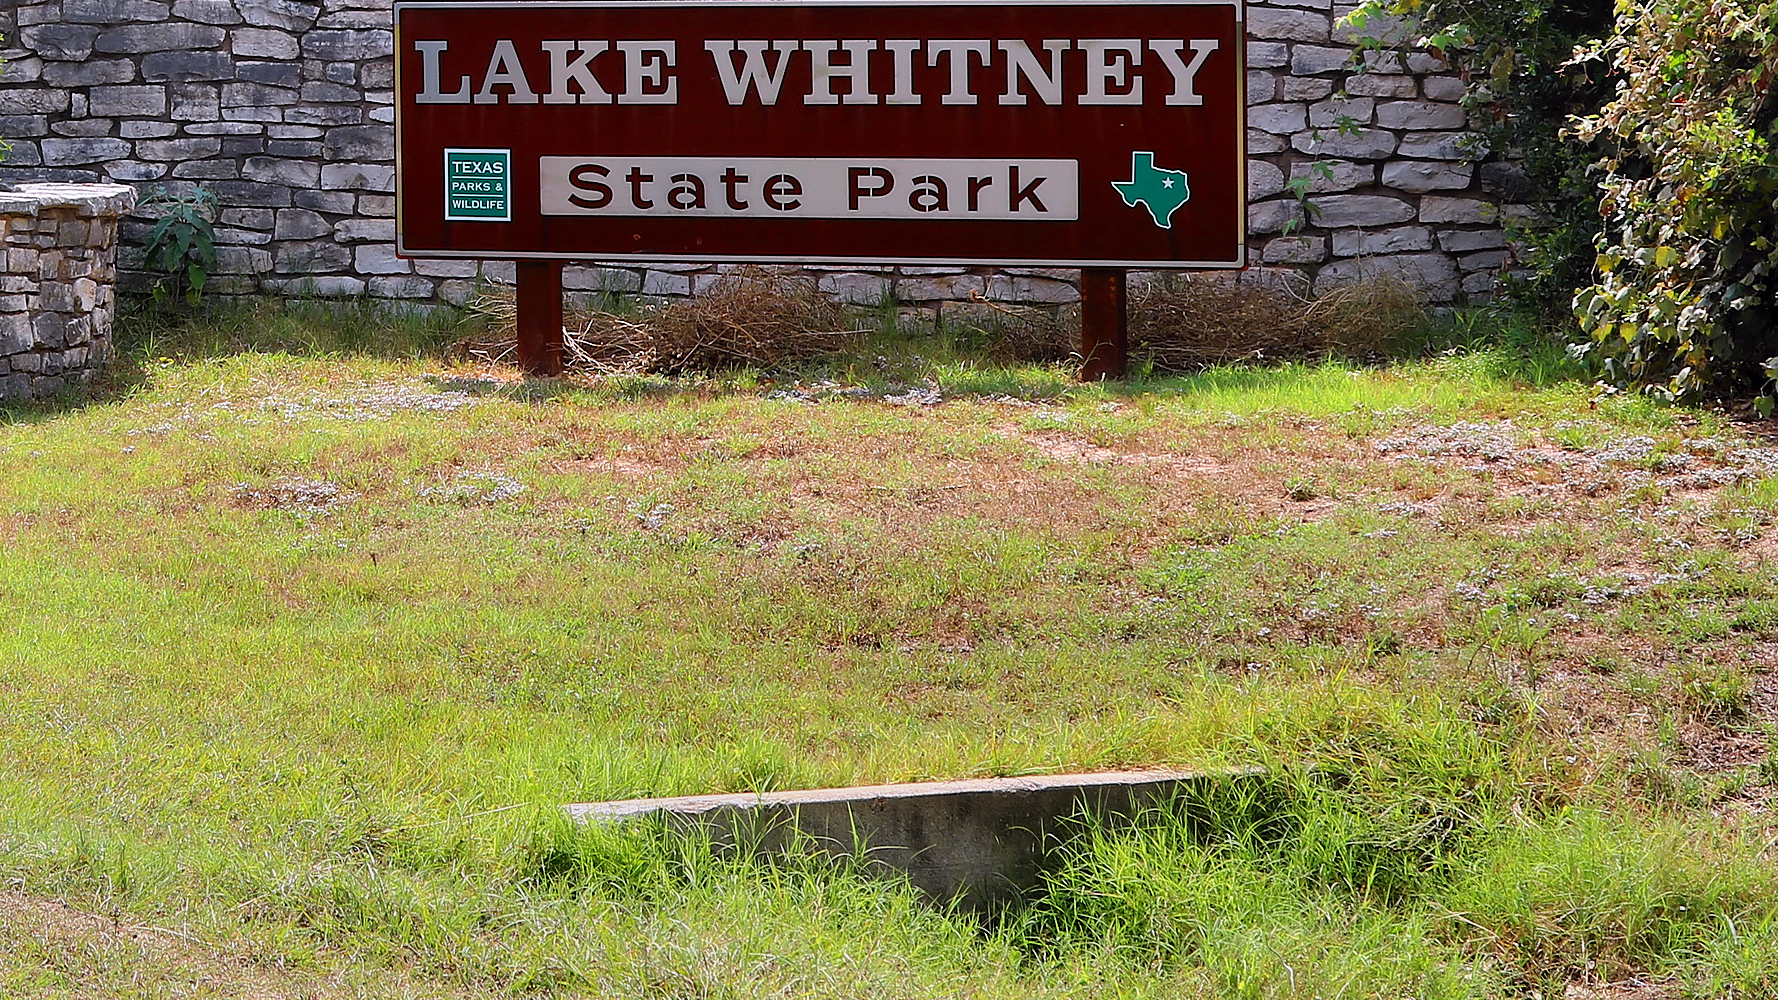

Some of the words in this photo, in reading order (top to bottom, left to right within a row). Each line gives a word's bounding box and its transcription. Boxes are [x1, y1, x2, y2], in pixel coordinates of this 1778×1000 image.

[414, 39, 678, 105] LAKE
[704, 39, 1219, 106] WHITNEY
[451, 161, 504, 174] TEXAS
[452, 181, 491, 191] PARKS
[495, 182, 504, 191] &
[566, 163, 804, 212] State
[847, 165, 1050, 213] Park
[452, 199, 505, 210] WILDLIFE
